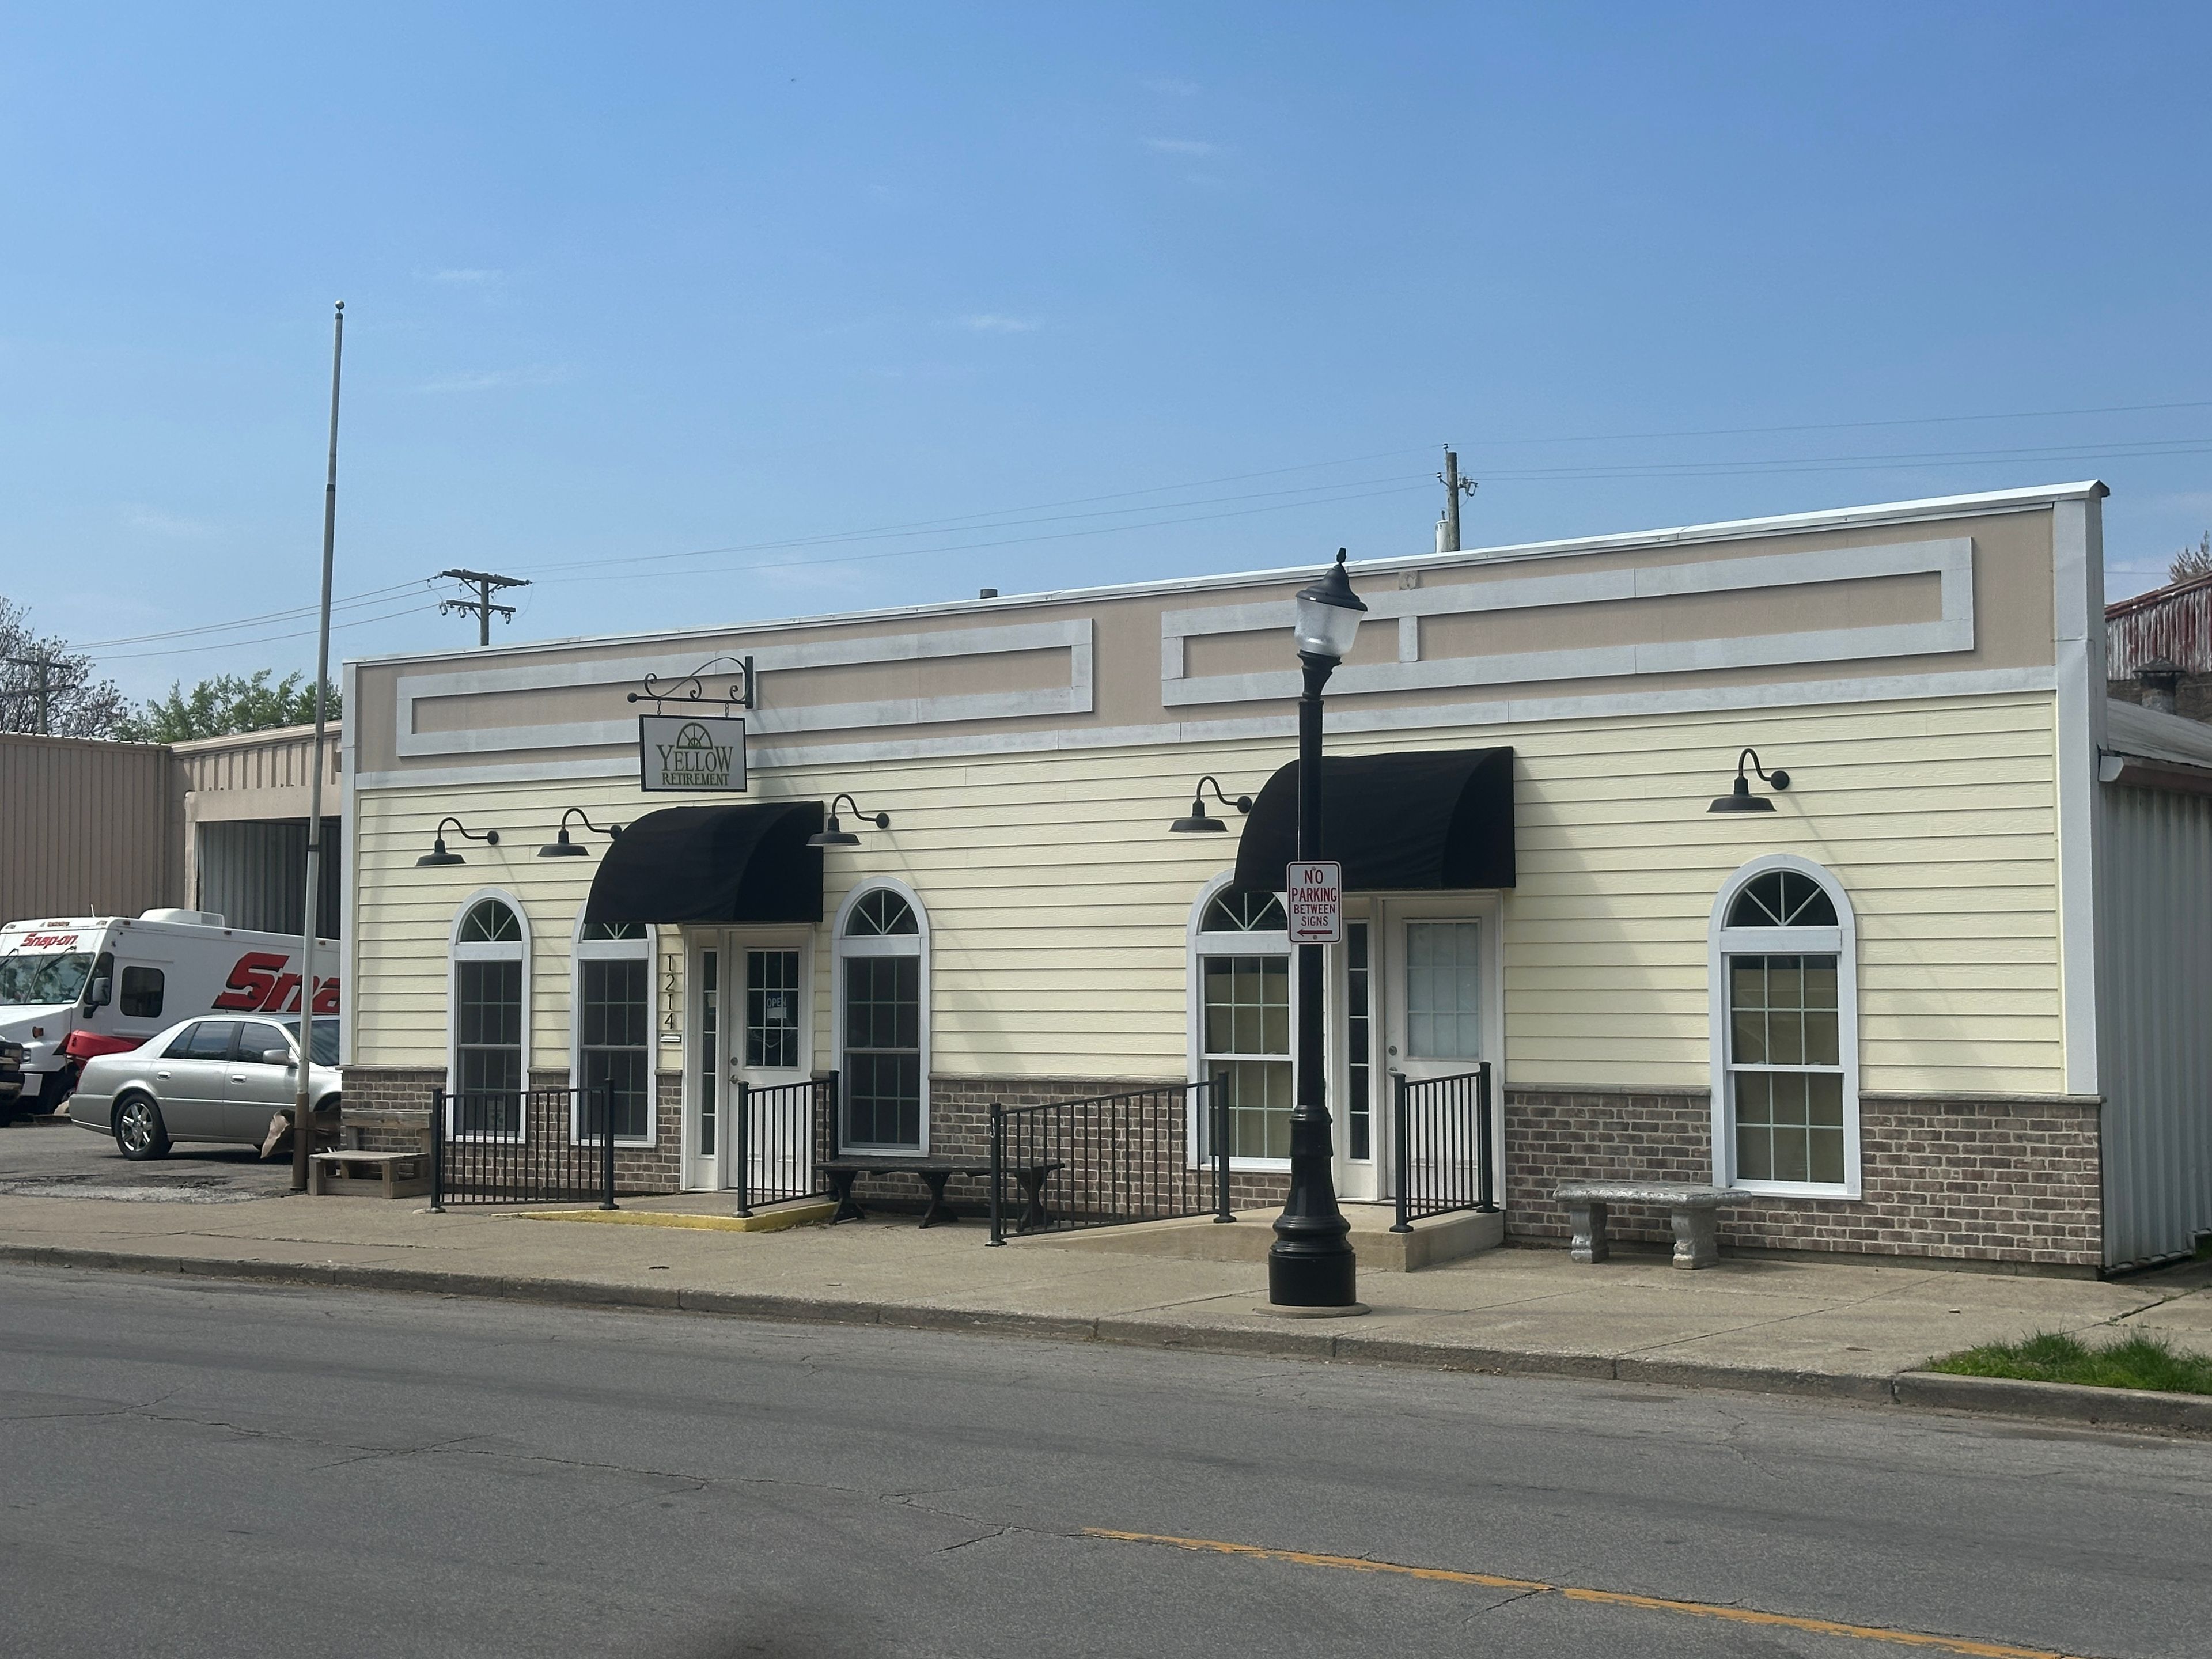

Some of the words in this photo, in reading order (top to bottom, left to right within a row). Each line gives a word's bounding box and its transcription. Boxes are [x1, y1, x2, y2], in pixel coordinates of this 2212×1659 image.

[656, 744, 733, 772] YELLOW
[662, 772, 729, 786] RETIREMENT
[1305, 870, 1324, 884] NO
[1291, 887, 1337, 902] PARKING
[1294, 904, 1336, 914] BETWEEN
[1301, 916, 1328, 926] SIGNS
[20, 933, 79, 949] Snap-on
[664, 955, 675, 1030] 1214
